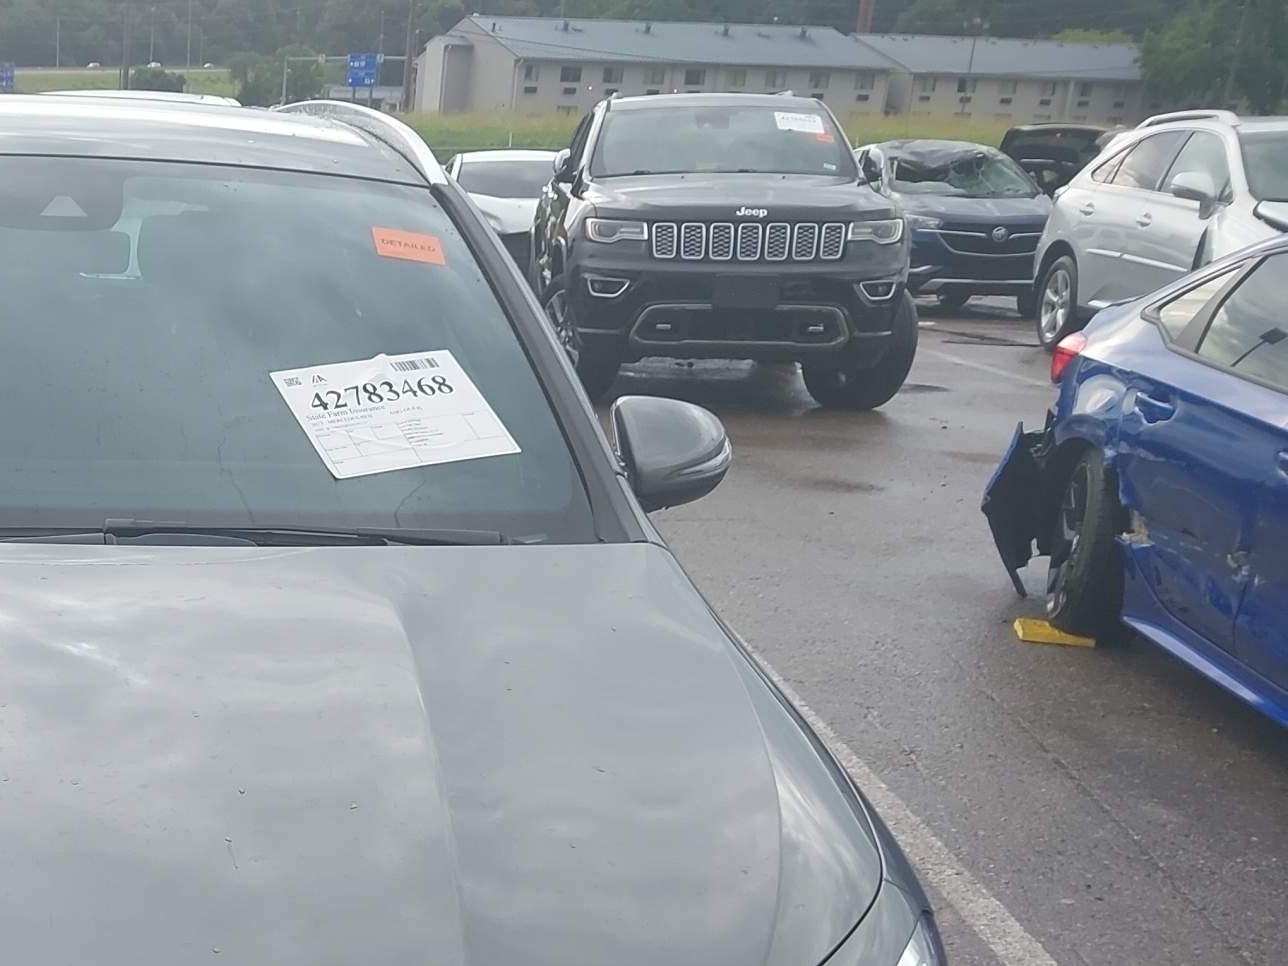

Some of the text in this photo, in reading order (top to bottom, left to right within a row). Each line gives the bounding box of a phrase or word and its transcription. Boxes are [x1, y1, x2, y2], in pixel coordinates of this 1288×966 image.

[735, 206, 768, 218] Jeep
[380, 238, 437, 253] DETAILED
[311, 375, 454, 411] 42783468
[327, 410, 348, 419] Farm
[349, 405, 387, 415] Insurance
